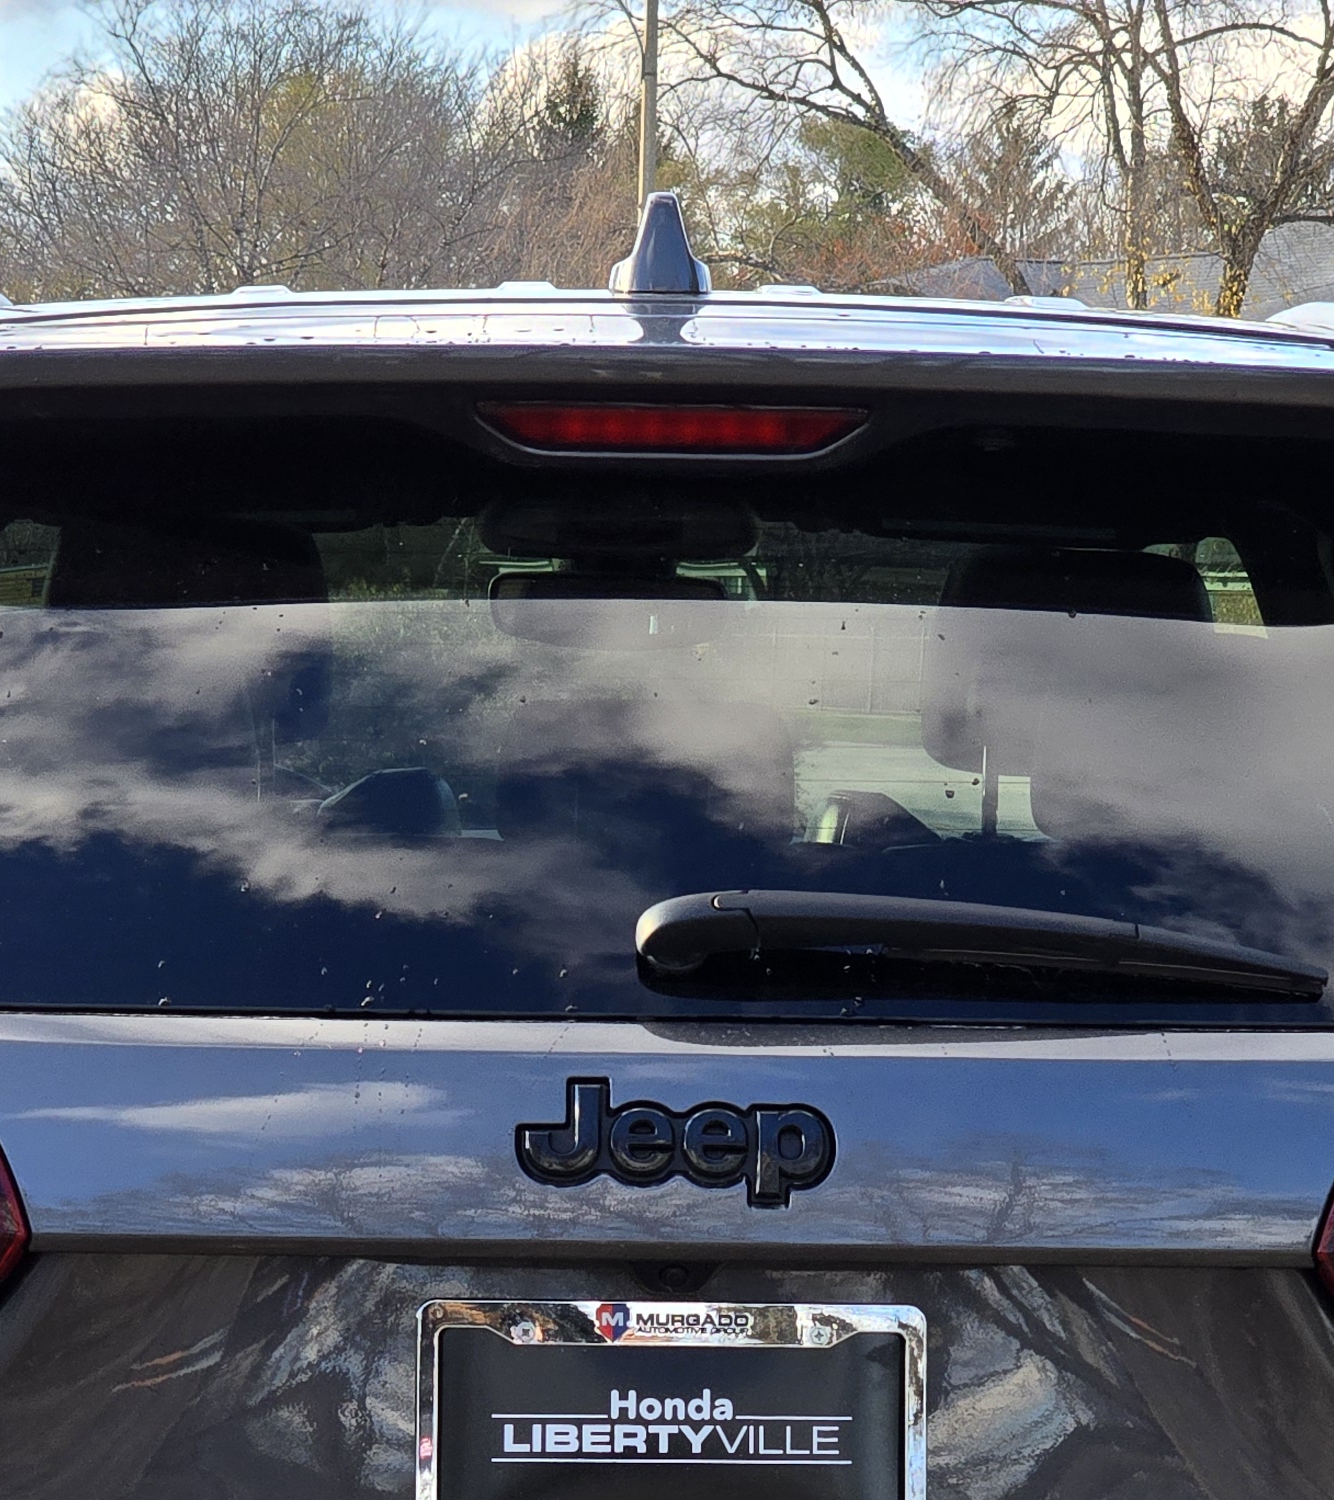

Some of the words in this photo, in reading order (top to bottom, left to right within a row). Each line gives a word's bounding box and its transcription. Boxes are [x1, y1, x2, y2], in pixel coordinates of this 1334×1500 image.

[517, 1078, 835, 1208] Jeep
[634, 1326, 708, 1335] AUTOMOTIVE
[635, 1313, 749, 1327] MURGADO
[610, 1388, 734, 1421] Honda
[503, 1423, 840, 1455] LIBERTYVILLE
